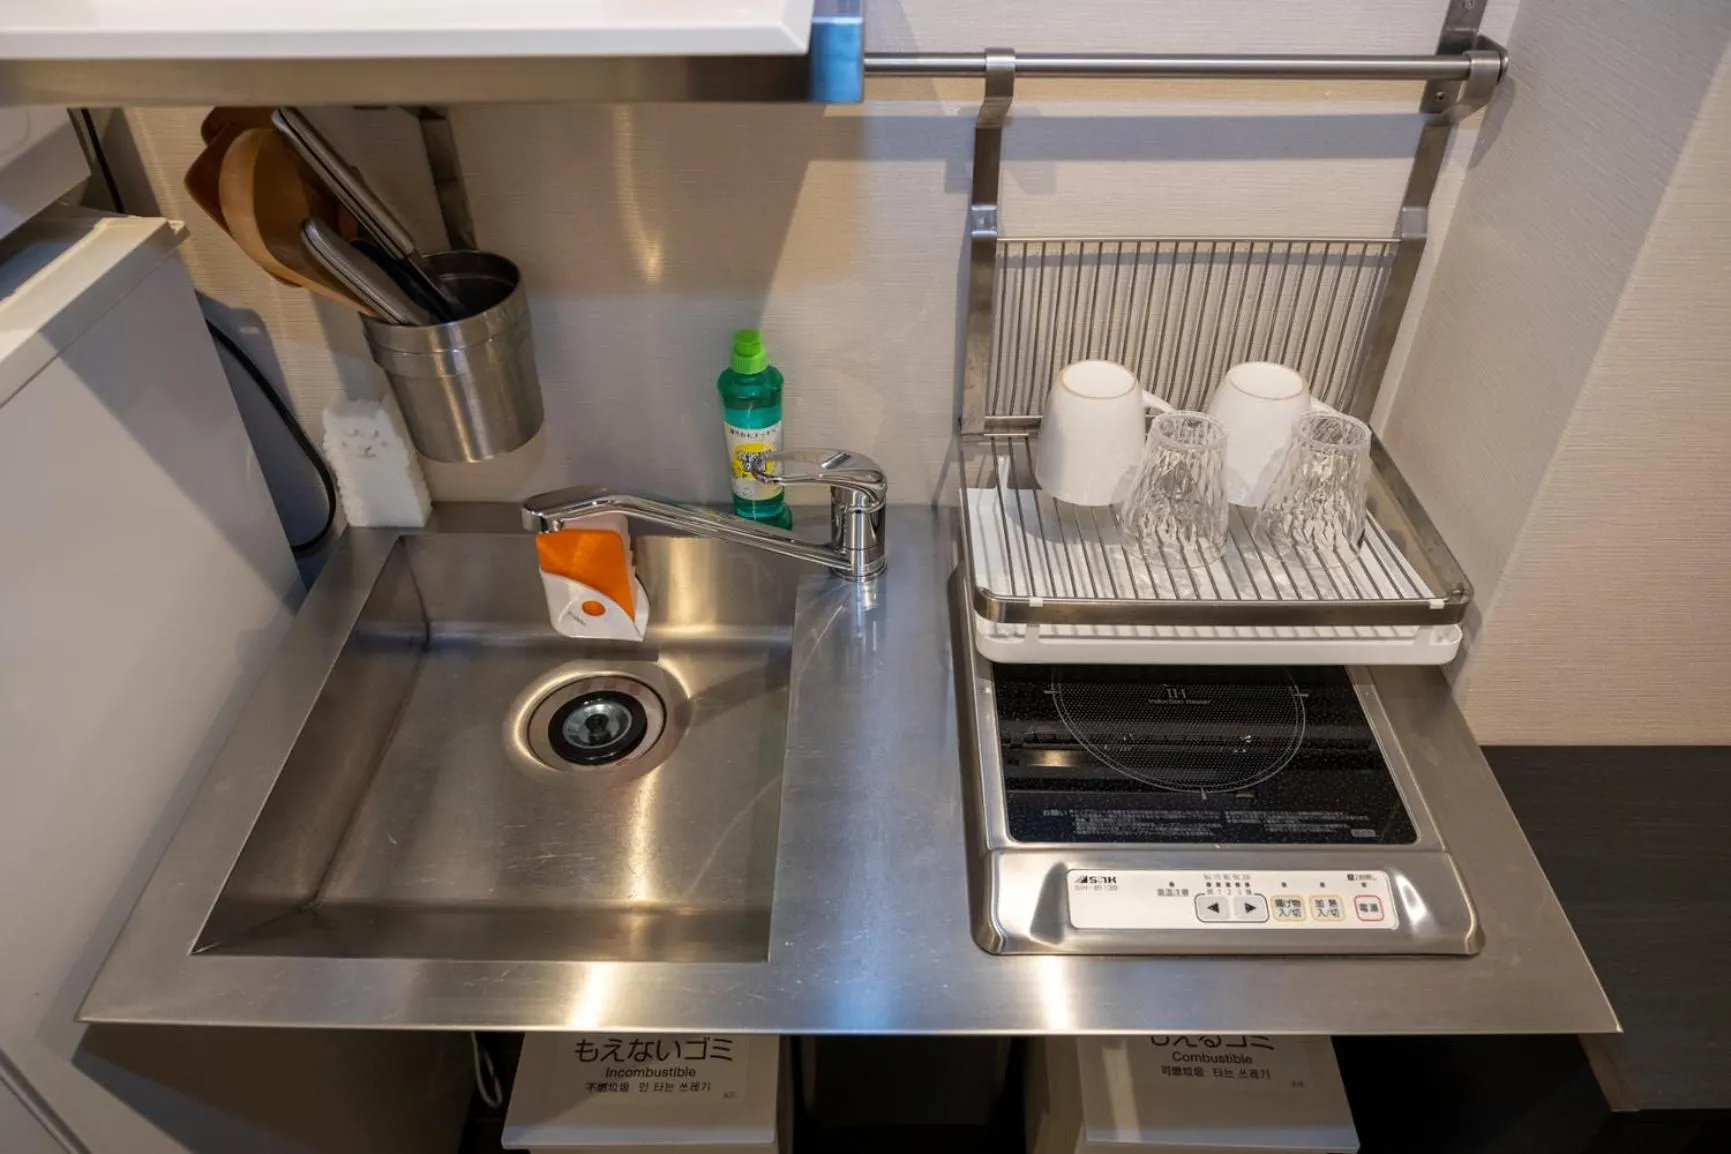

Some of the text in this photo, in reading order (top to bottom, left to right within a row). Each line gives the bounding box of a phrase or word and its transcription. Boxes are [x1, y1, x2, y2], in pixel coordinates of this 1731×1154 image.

[574, 1036, 733, 1063] もえないゴミ
[1172, 1051, 1254, 1066] Combustible
[605, 1067, 697, 1078] Incombustible
